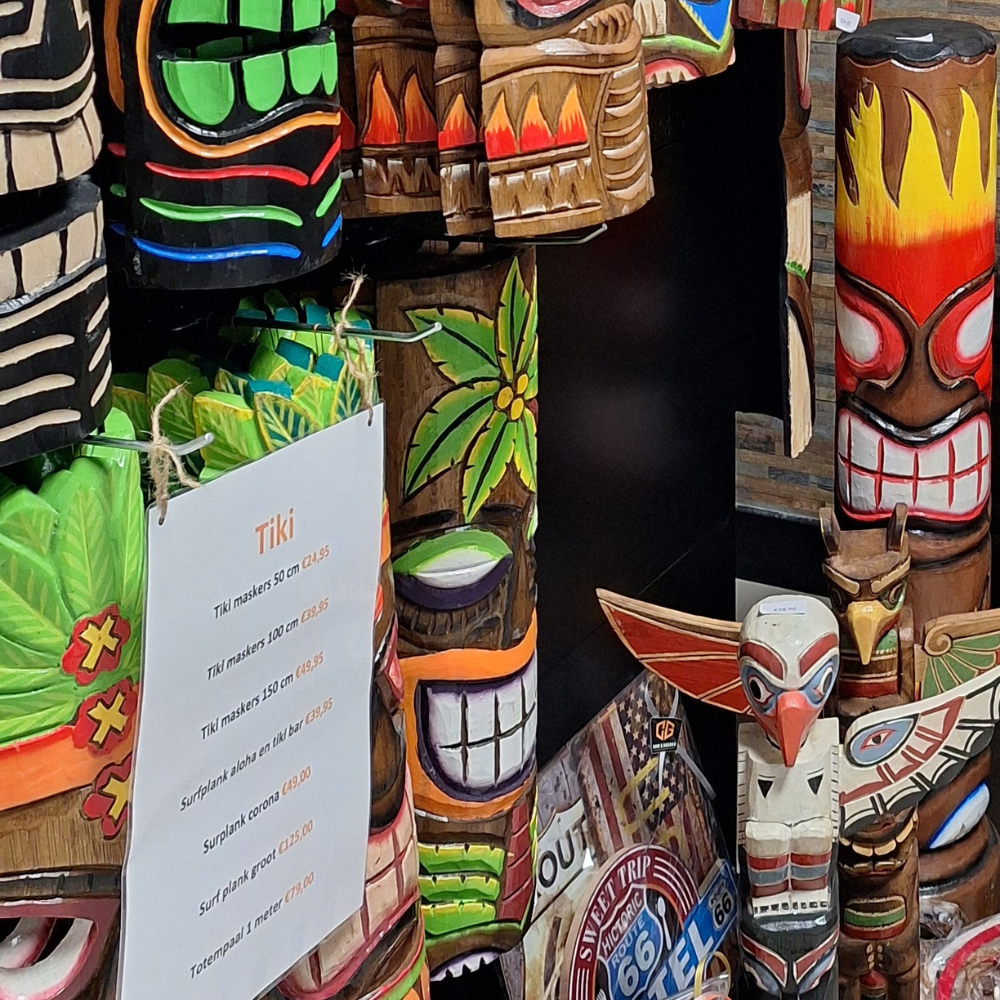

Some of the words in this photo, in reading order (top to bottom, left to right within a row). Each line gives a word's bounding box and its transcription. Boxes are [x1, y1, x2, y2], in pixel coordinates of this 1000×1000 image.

[254, 507, 295, 555] Tiki
[213, 598, 232, 620] Tiki
[233, 579, 272, 609] maskers
[273, 569, 285, 586] 50
[286, 563, 300, 578] cm
[301, 544, 330, 570] €24,95
[207, 659, 225, 681] Tiki
[226, 638, 266, 670] maskers
[267, 624, 284, 645] 100
[285, 618, 299, 633] cm
[300, 597, 329, 624] €39,95
[200, 718, 219, 740] Tiki
[220, 694, 260, 728] maskers
[262, 680, 279, 702] 150
[280, 673, 294, 689] cm
[295, 651, 324, 679] €49,95
[180, 769, 229, 812] Surfplank
[230, 751, 257, 777] aloha
[258, 742, 270, 758] en
[272, 727, 288, 748] tiki
[288, 719, 304, 738] bar
[304, 697, 333, 725] €39,95
[203, 813, 246, 855] Surplank
[248, 790, 280, 821] corona
[281, 765, 311, 796] €49,00
[537, 812, 589, 889] OUT
[199, 888, 222, 917] Surf
[222, 868, 249, 902] plank
[250, 848, 277, 880] groot
[278, 819, 313, 855] €125,00
[579, 877, 617, 962] SWEET
[617, 855, 652, 890] TRIP
[714, 891, 732, 926] 66
[190, 926, 245, 980] Totempaal
[246, 920, 252, 936] 1
[254, 898, 283, 929] meter
[284, 871, 315, 903] €79,00
[611, 914, 646, 969] ROUTE
[617, 930, 656, 997] 66
